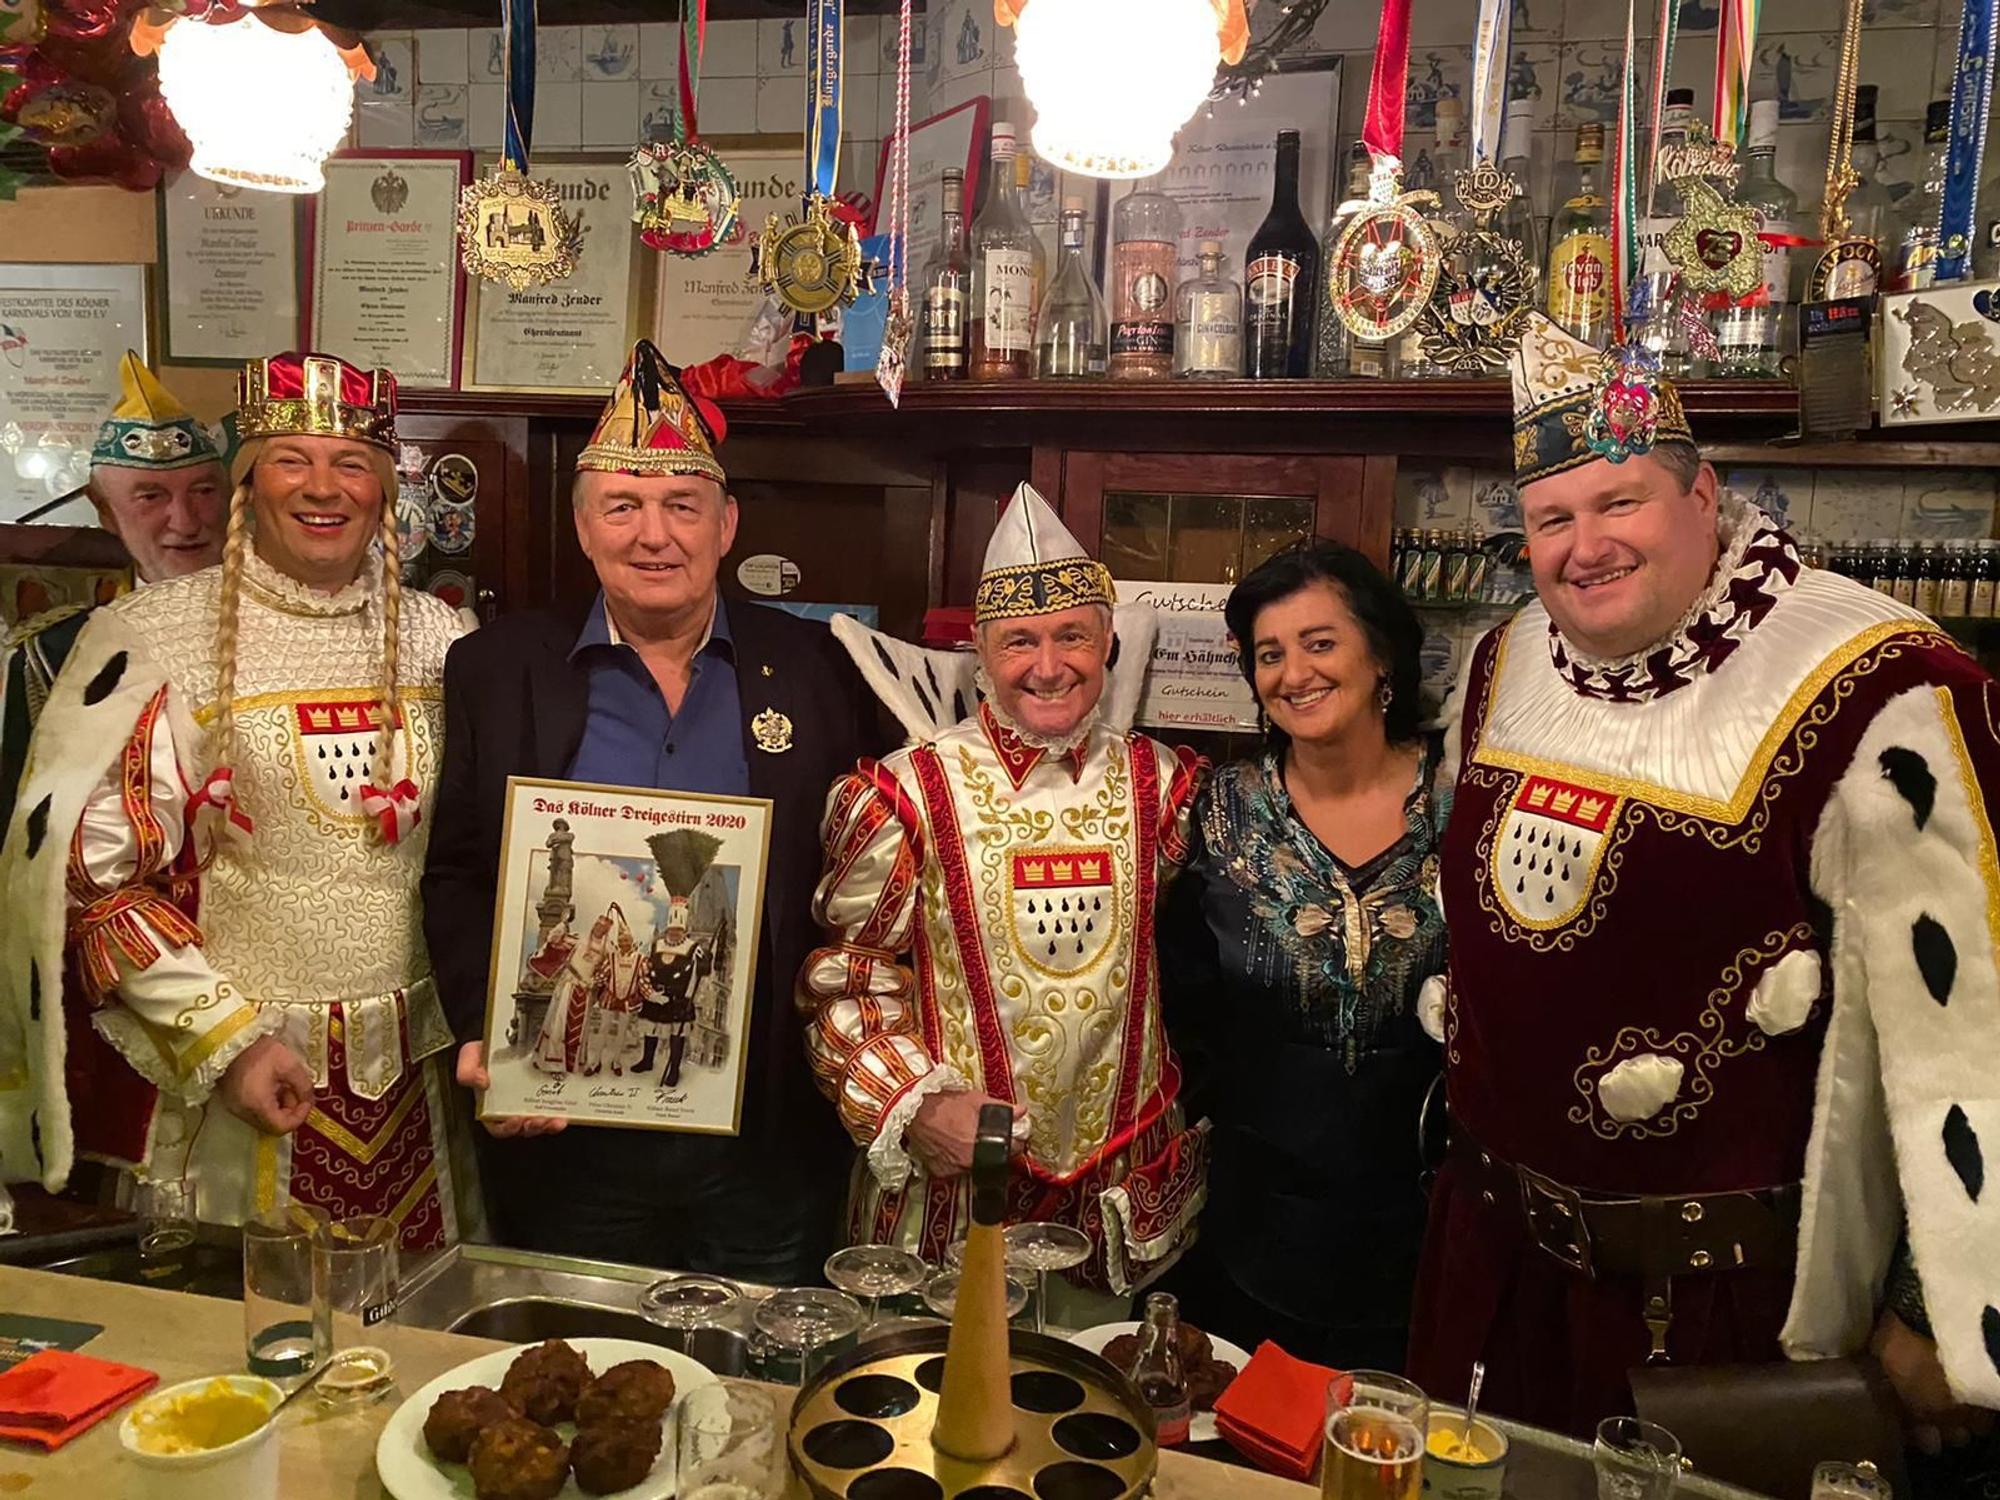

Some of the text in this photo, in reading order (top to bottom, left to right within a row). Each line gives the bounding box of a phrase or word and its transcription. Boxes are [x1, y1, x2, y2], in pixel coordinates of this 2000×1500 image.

[821, 24, 838, 108] Bürgergarde
[508, 292, 603, 307] Manfred Zender
[1136, 592, 1228, 613] Gutsche
[1183, 649, 1237, 666] Hähnch
[1162, 684, 1230, 699] Gutschein
[1158, 711, 1237, 725] hier erhältlich
[533, 797, 747, 830] Das Kölner Dreigestirn 2020
